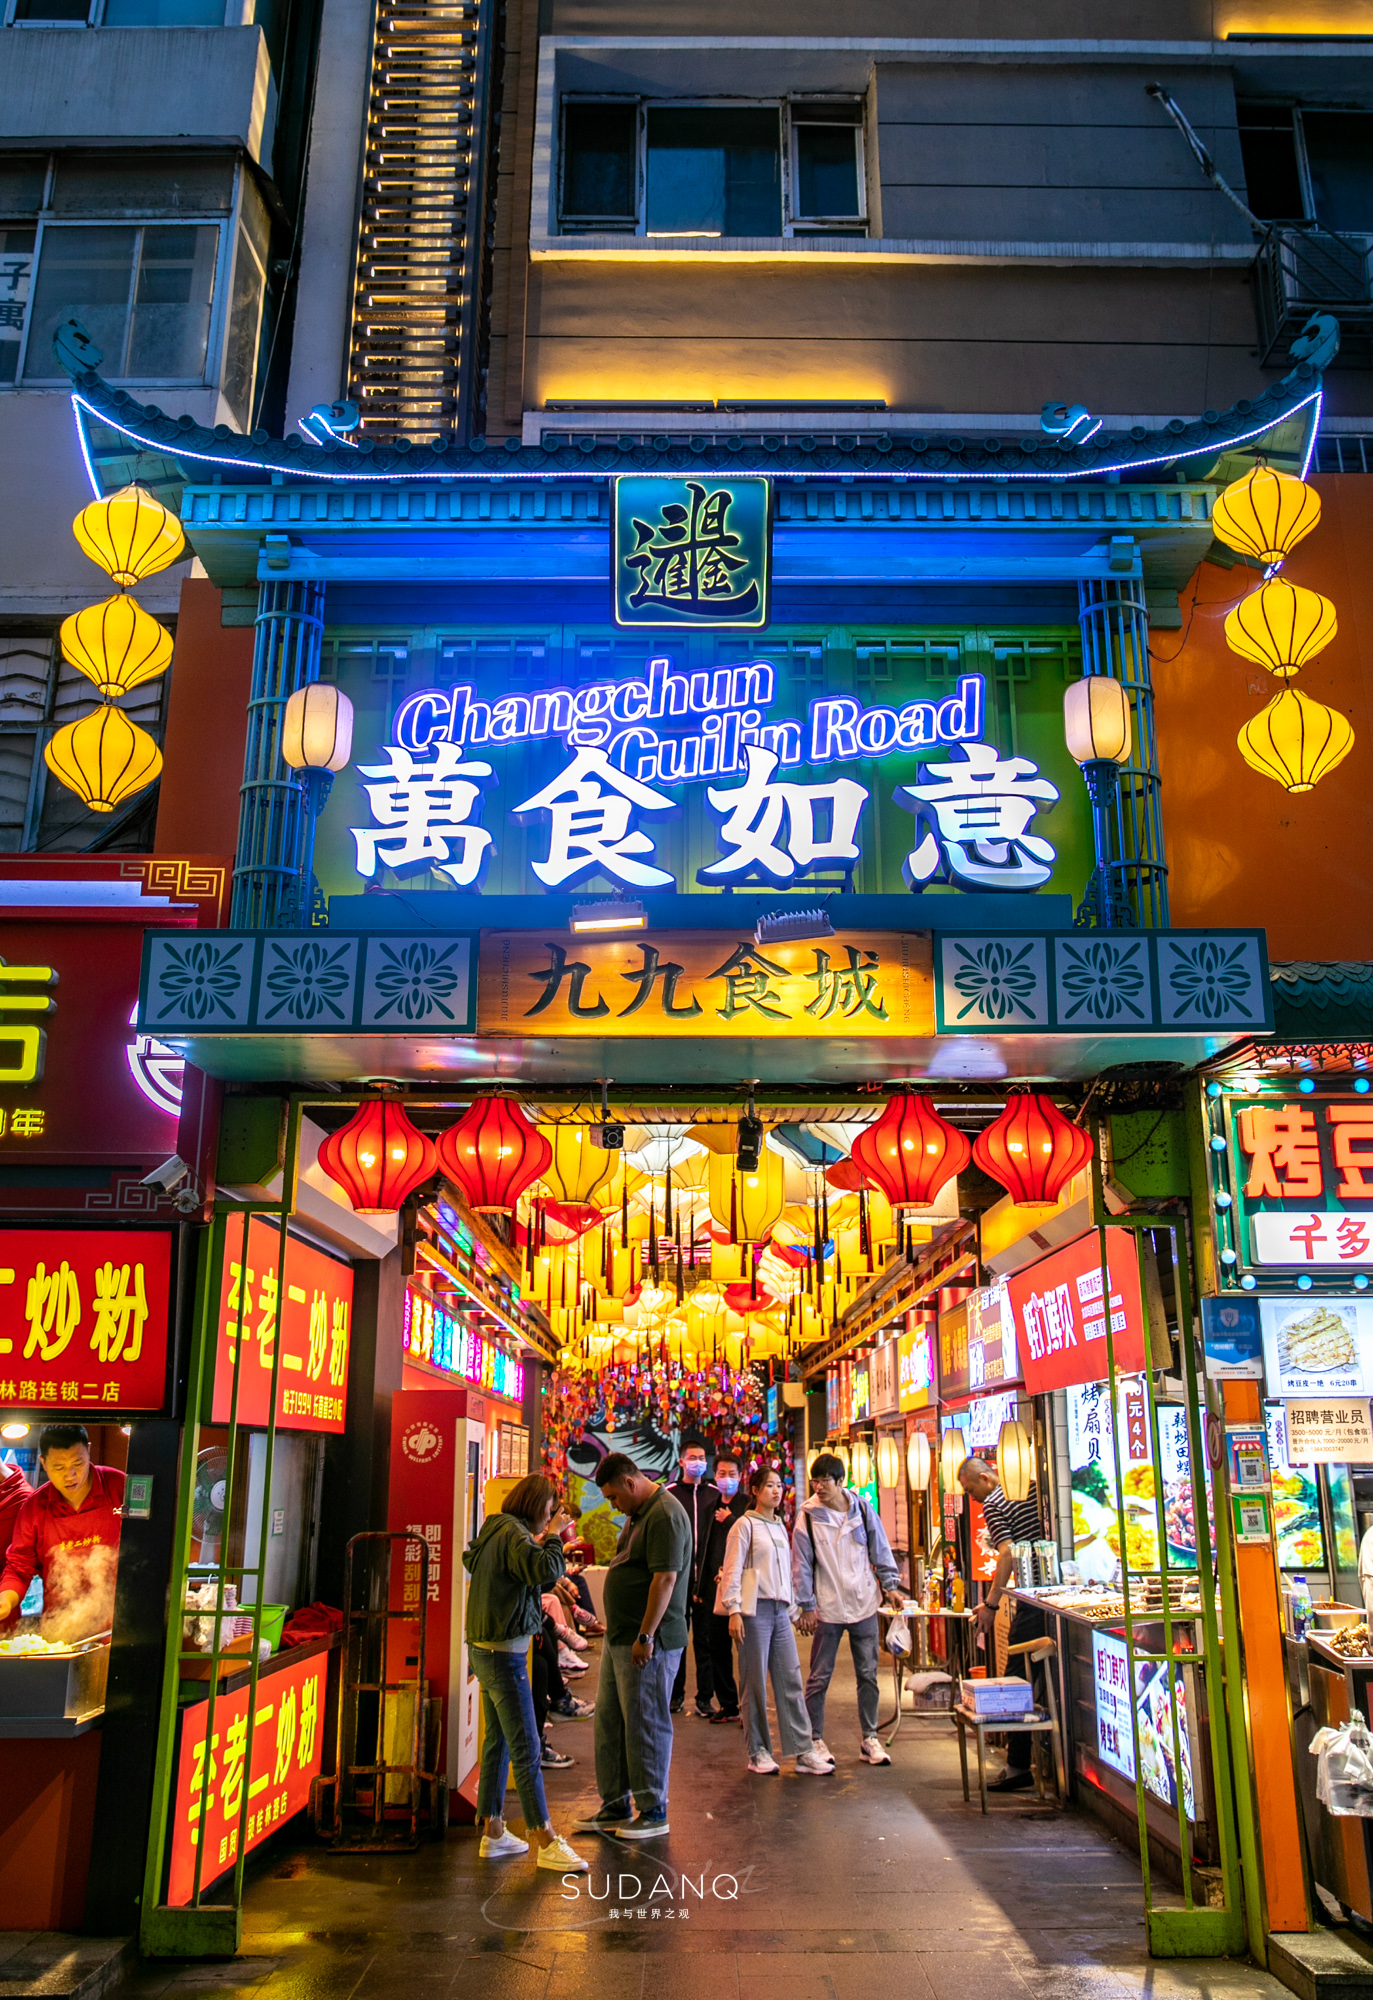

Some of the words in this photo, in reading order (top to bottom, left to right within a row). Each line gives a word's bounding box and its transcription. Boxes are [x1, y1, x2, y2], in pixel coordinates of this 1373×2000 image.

[396, 655, 776, 752] Changchun
[607, 708, 801, 786] Guilin
[811, 673, 985, 760] Road
[350, 742, 1060, 891] 萬食如意
[523, 942, 890, 1022] 九九食城
[226, 1261, 348, 1387] 李老二炒粉
[1081, 1383, 1102, 1460] 烤扇贝
[1290, 1409, 1364, 1425] 招聘营业员
[1329, 1379, 1357, 1387] 6元20串
[188, 1674, 318, 1845] 李老二炒粉
[218, 1790, 288, 1864] 国贸锁桂林路店
